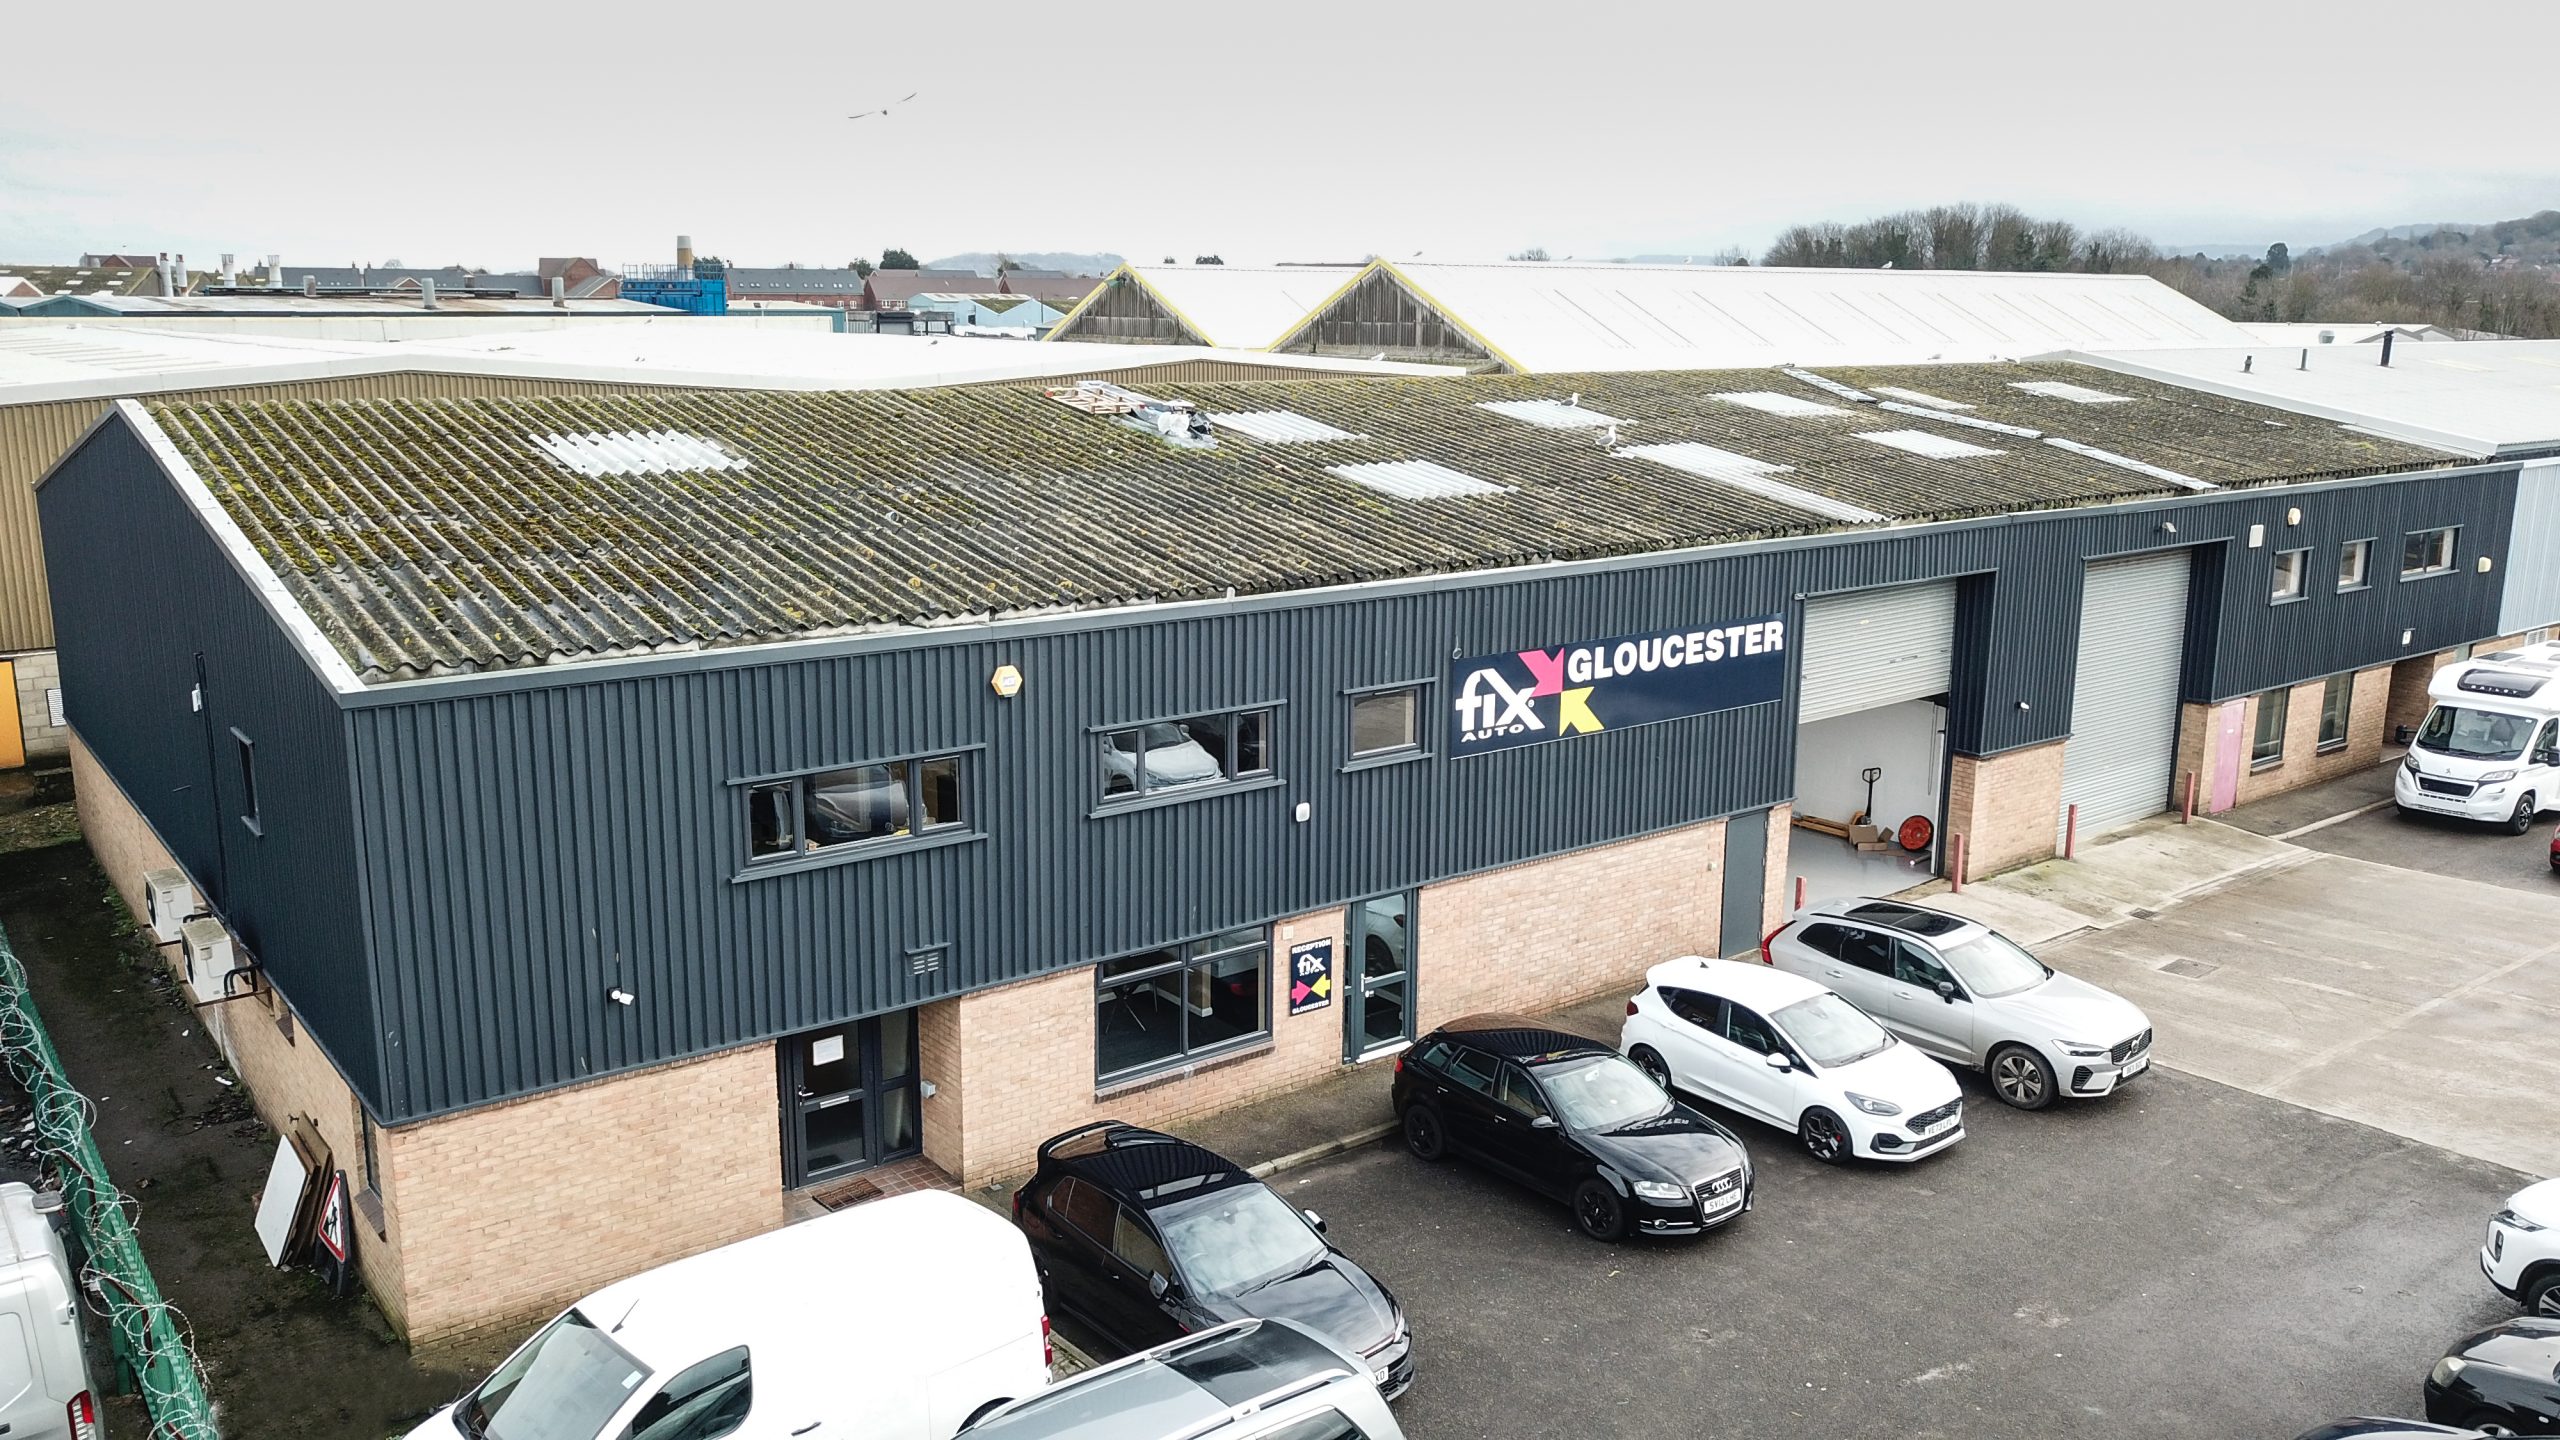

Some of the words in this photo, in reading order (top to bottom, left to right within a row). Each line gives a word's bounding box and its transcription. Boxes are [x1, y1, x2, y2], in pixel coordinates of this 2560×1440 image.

[1568, 620, 1784, 683] GLOUCESTER
[1456, 667, 1545, 732] fix
[1461, 723, 1524, 743] AUTO
[1292, 939, 1331, 954] RECEPTION
[1292, 999, 1329, 1014] GLOUCESTER
